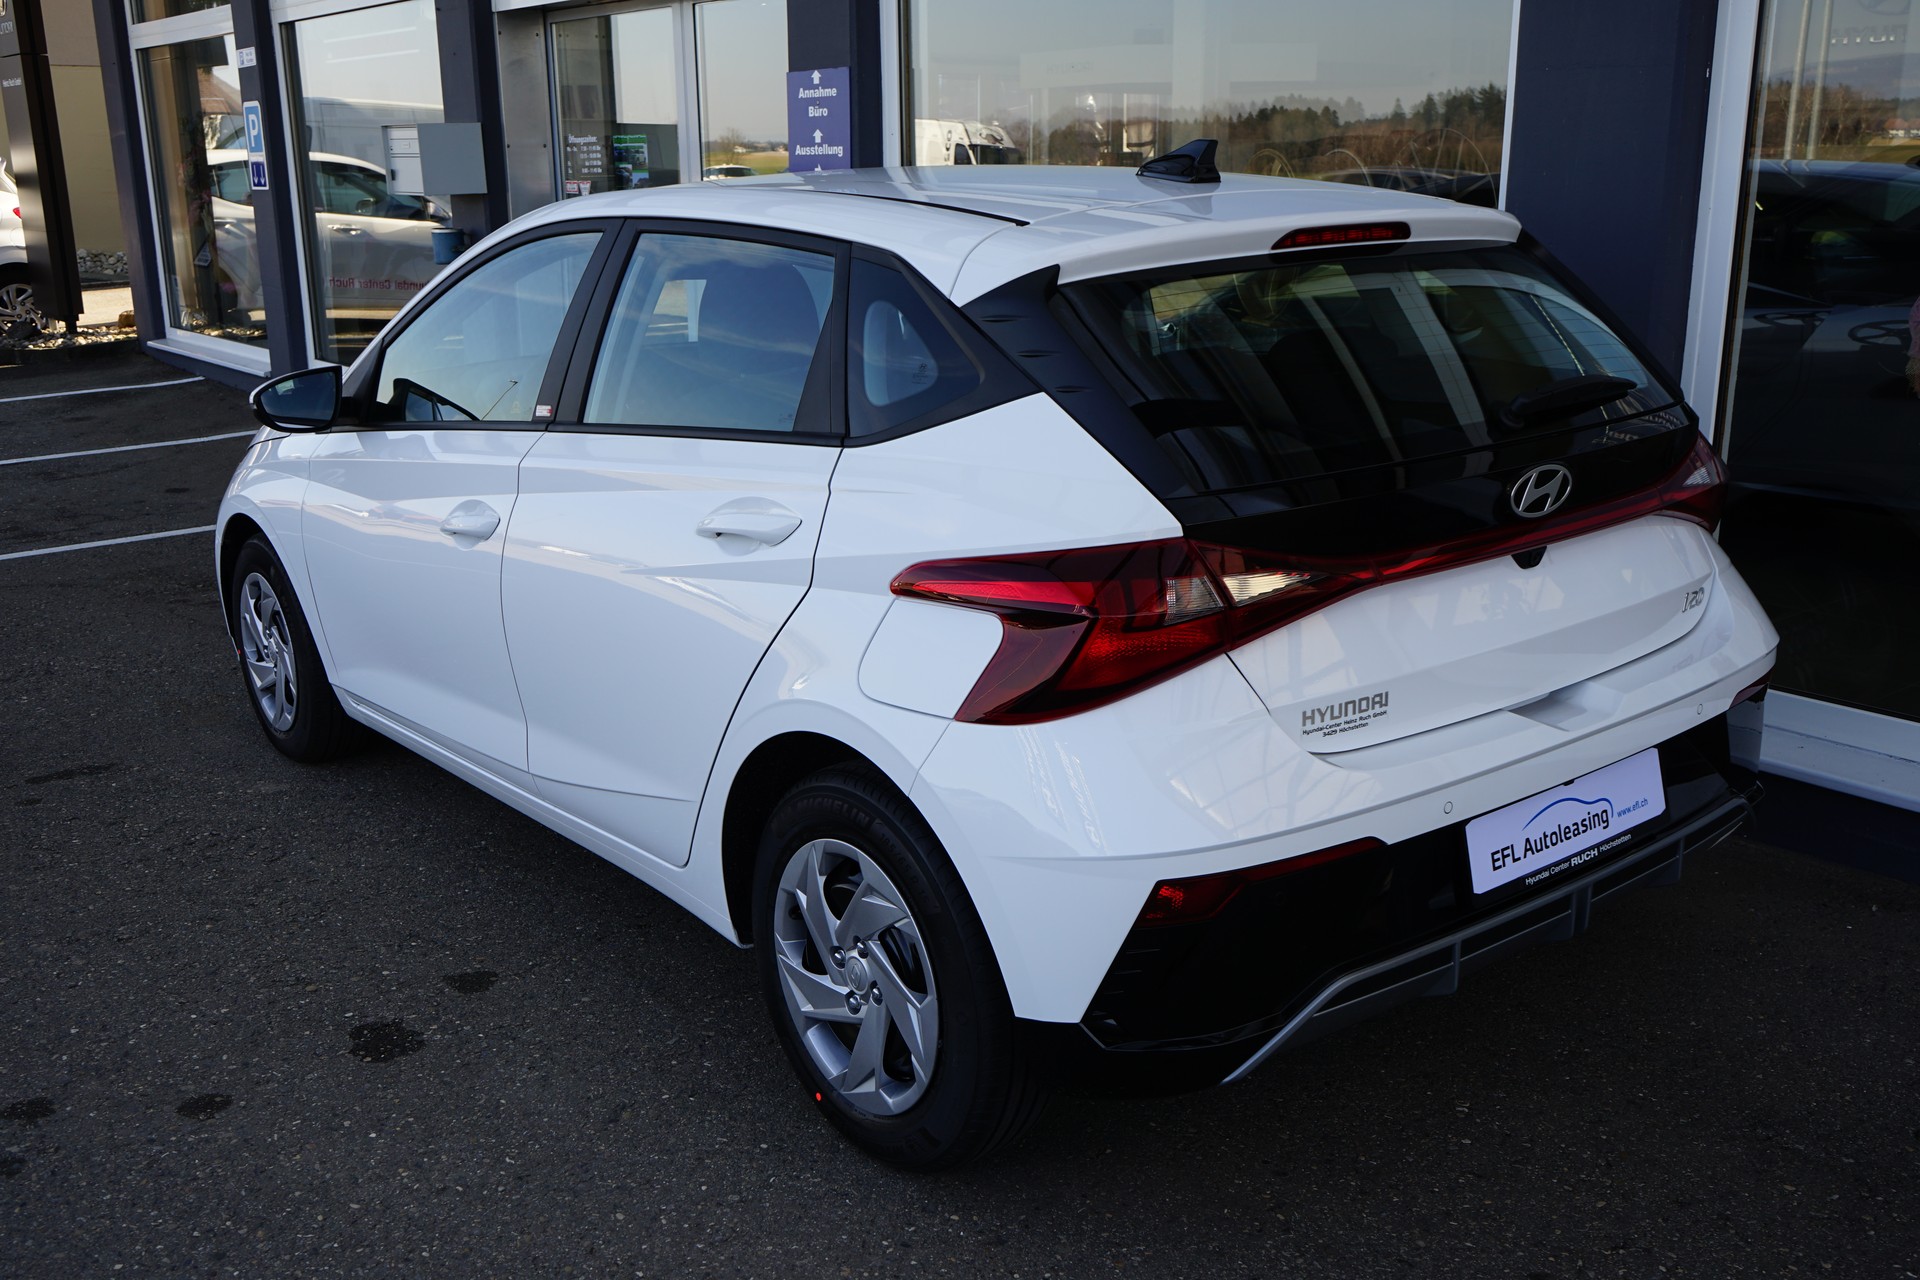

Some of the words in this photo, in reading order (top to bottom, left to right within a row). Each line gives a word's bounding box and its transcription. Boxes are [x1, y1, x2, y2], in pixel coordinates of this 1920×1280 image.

[798, 86, 837, 98] Annahme
[808, 106, 828, 117] Büro
[248, 113, 259, 147] P
[795, 144, 843, 157] Ausstellung
[1302, 691, 1389, 727] HYUNDAI
[1302, 721, 1342, 736] Hyundai-Center
[1343, 717, 1358, 726] Heinz
[1359, 714, 1371, 723] Ruch
[1616, 797, 1649, 818] www.efl.ch
[1490, 843, 1522, 872] EFL
[1523, 808, 1609, 860] Autoleasing
[1525, 868, 1550, 885] Hyundai
[1550, 860, 1571, 875] Center
[1571, 848, 1599, 867] RUCH
[1599, 833, 1632, 852] Höchstetten
